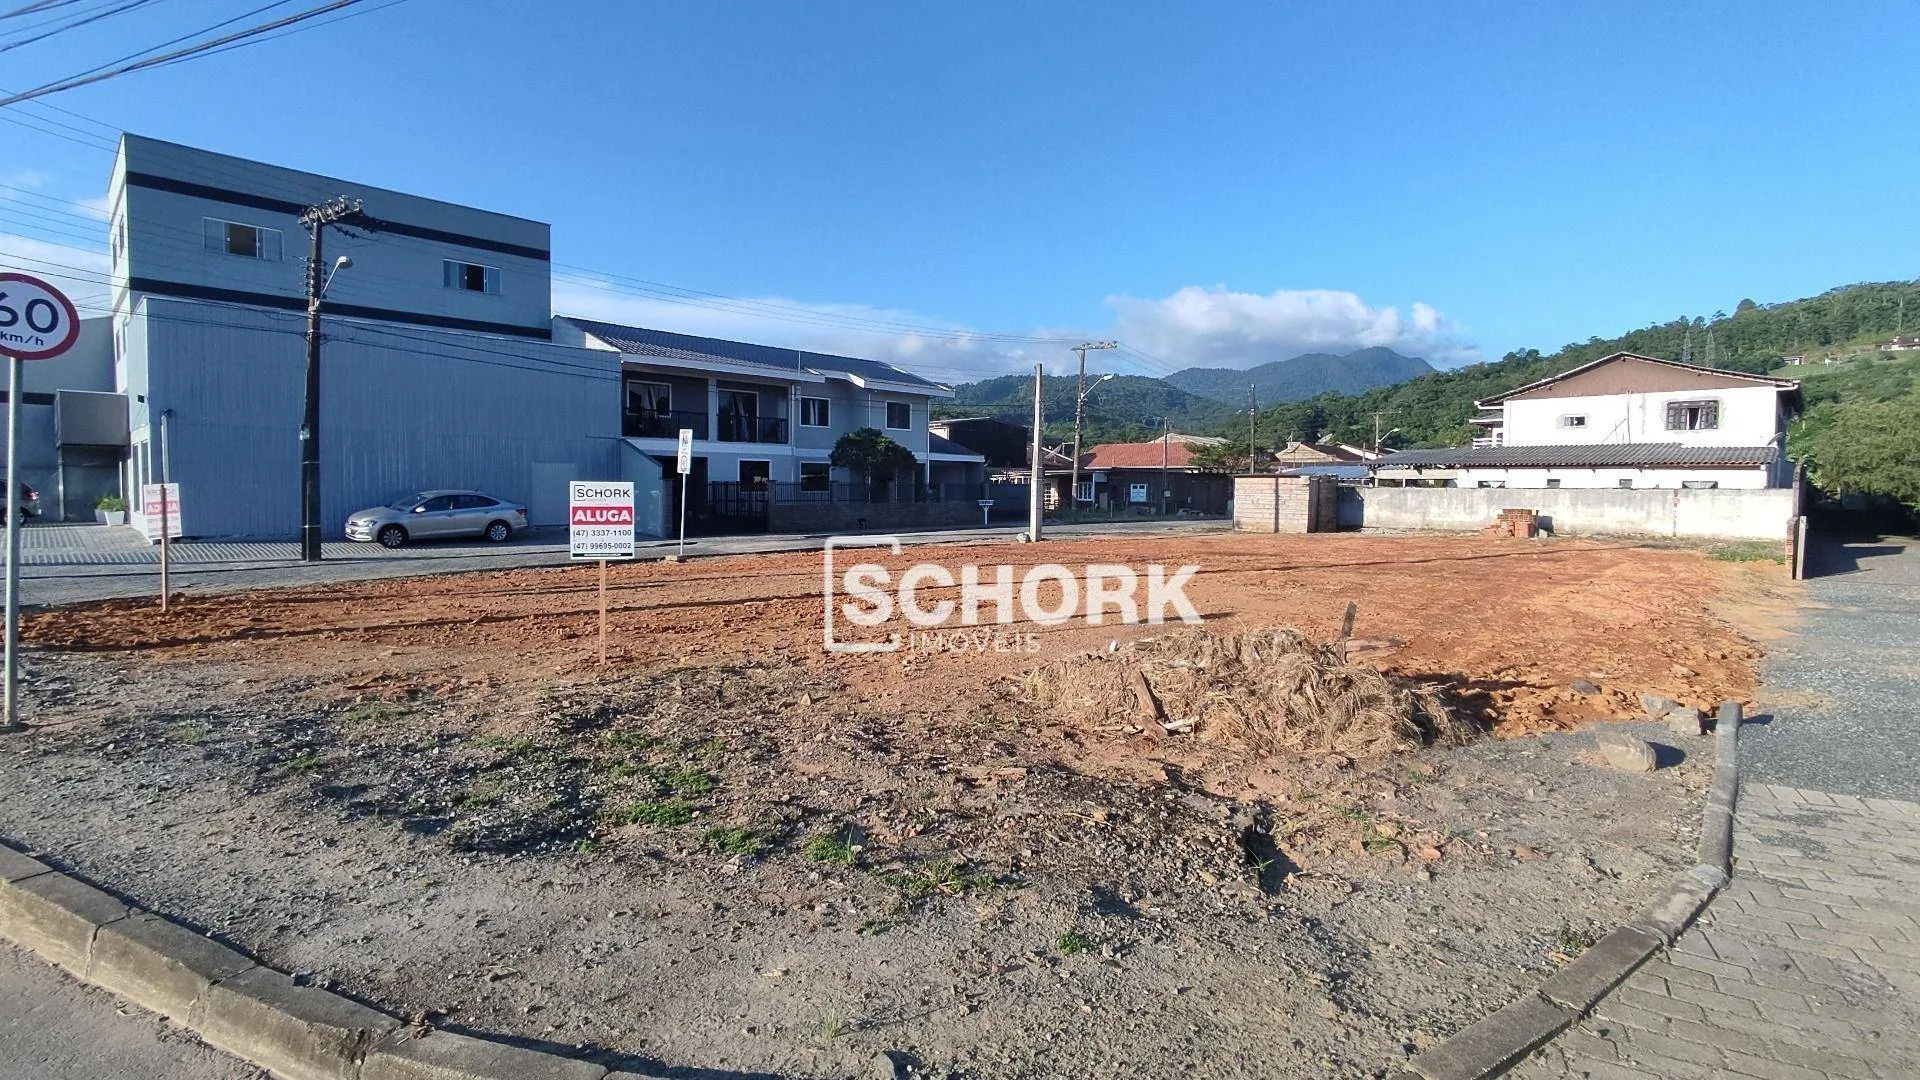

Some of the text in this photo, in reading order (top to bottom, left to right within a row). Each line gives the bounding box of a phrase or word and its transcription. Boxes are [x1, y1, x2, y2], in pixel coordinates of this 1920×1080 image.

[0, 331, 44, 346] km/h
[577, 488, 630, 498] SCHORK
[573, 509, 632, 522] ALUGA
[573, 529, 632, 538] (47) 3337-1100
[573, 542, 631, 551] (47) 99695-0002
